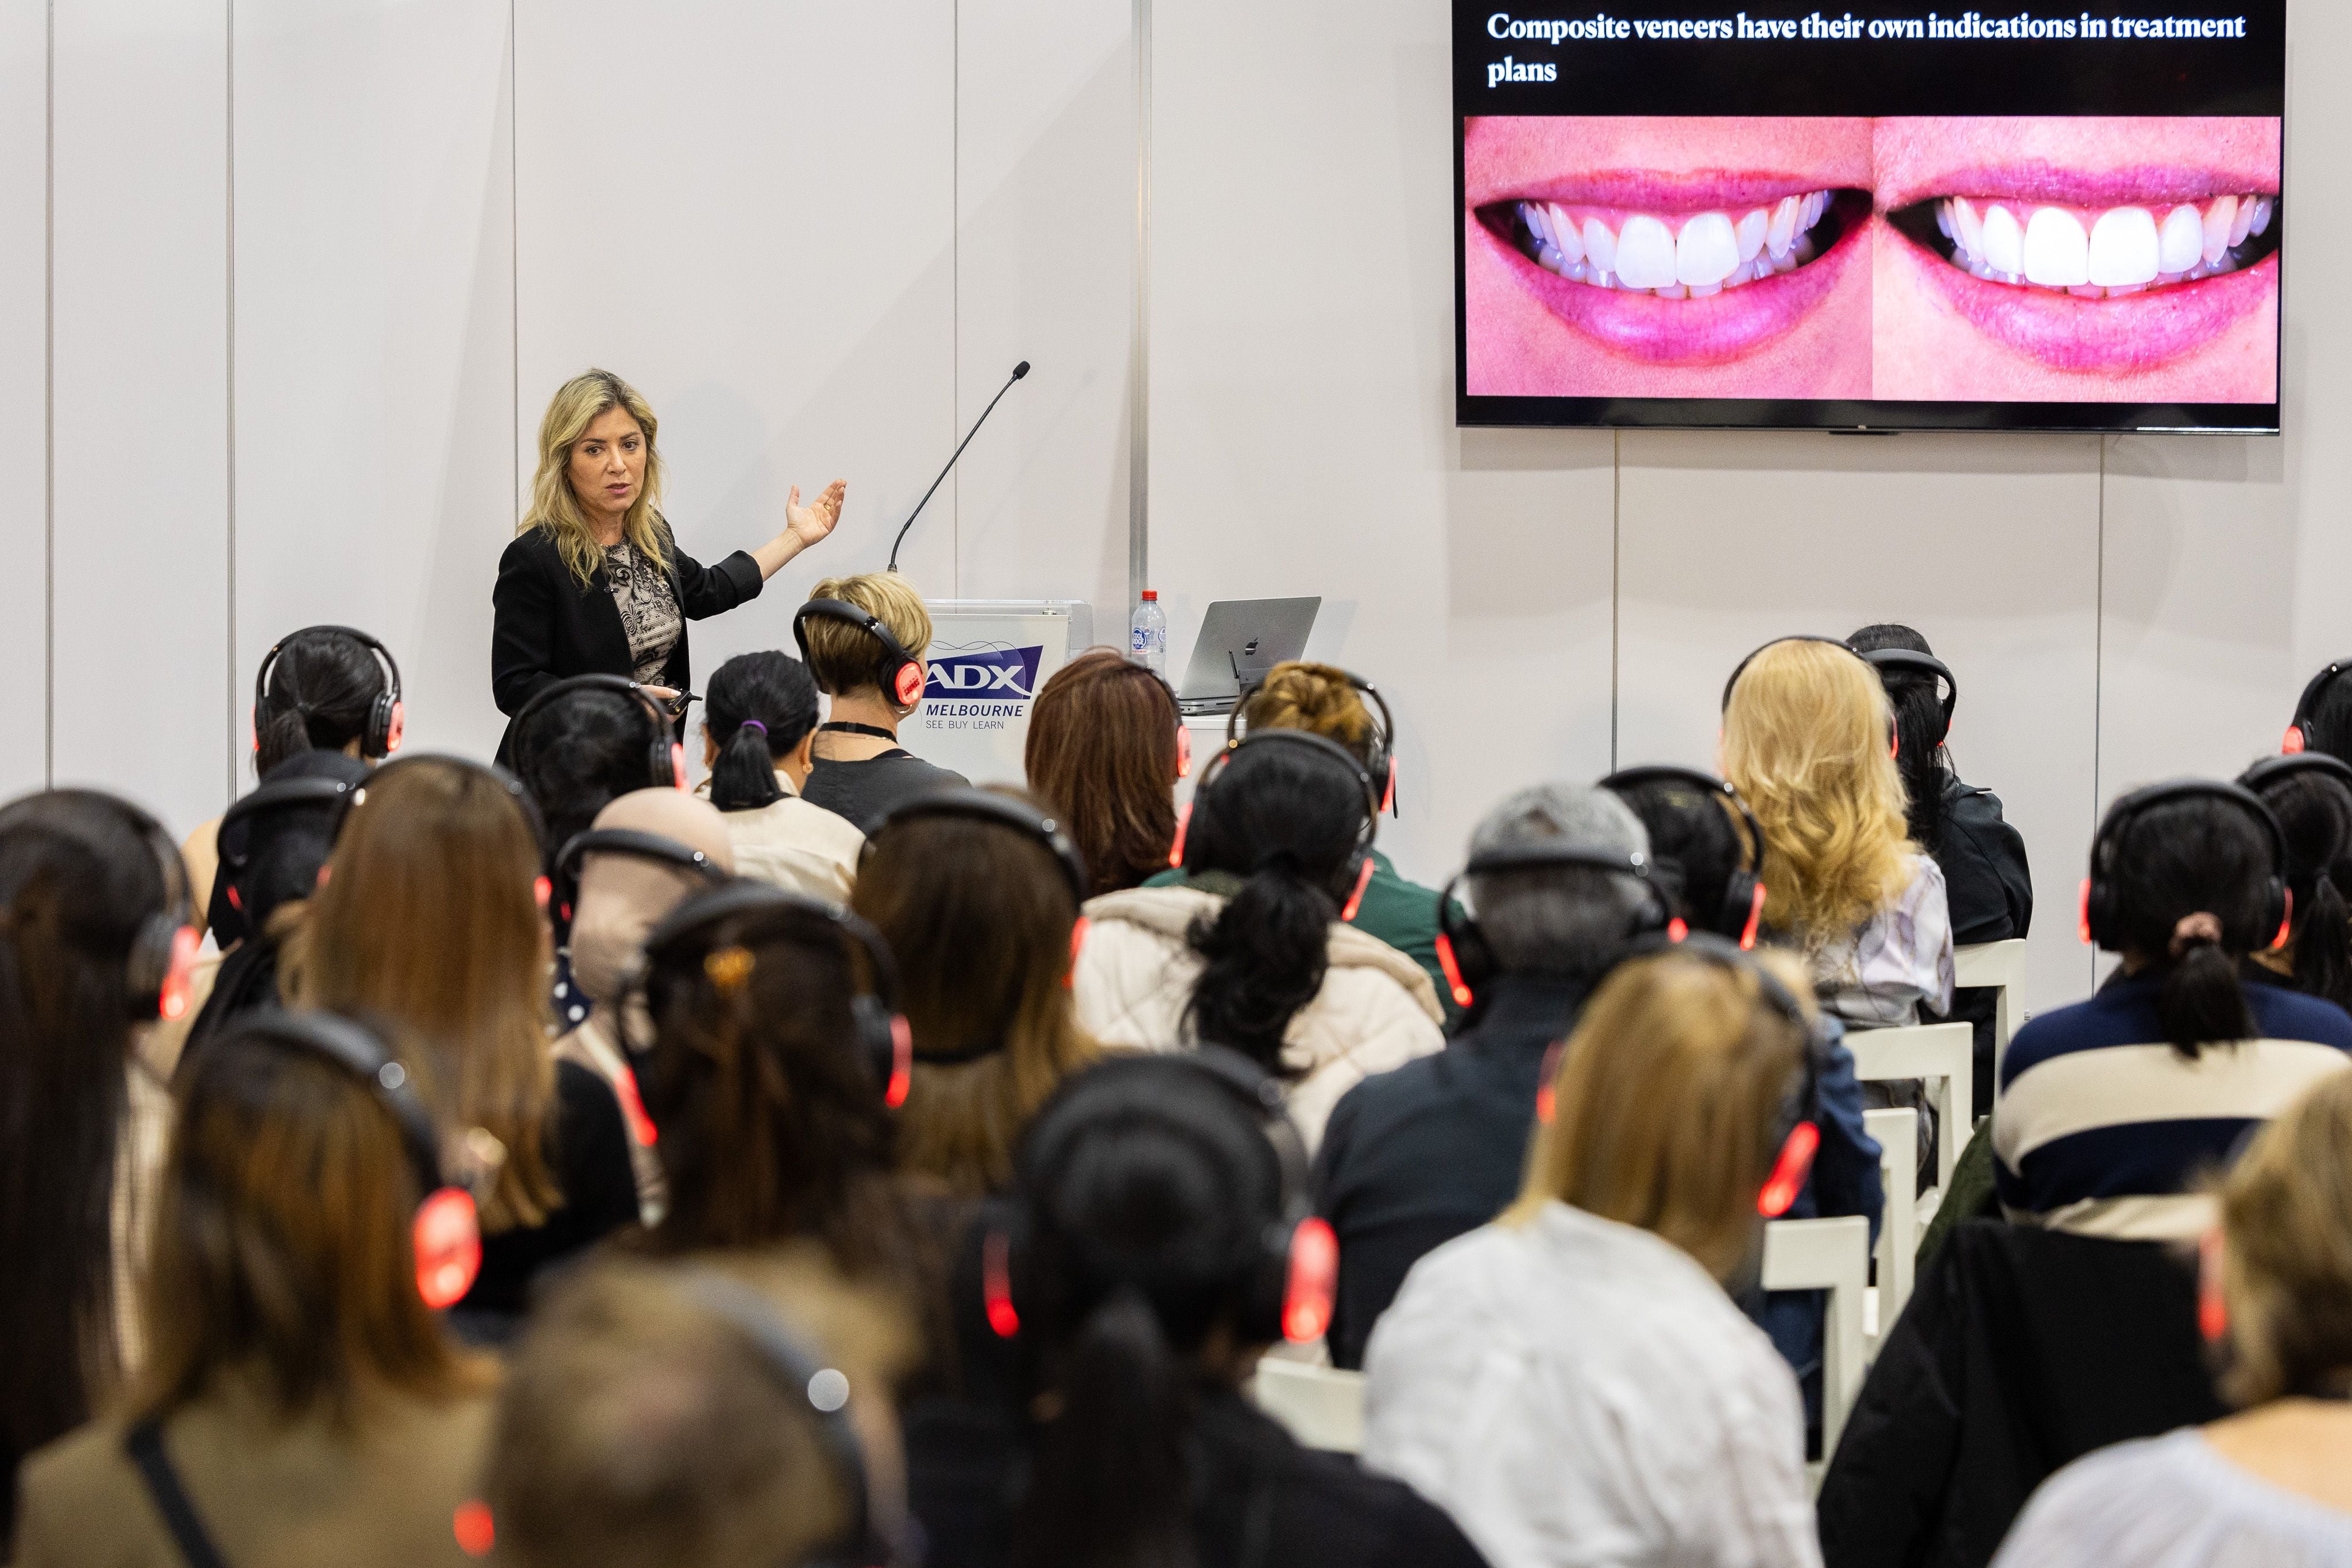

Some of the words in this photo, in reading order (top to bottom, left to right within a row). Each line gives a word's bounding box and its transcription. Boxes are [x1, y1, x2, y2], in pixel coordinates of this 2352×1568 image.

[1487, 13, 1630, 45] Composite
[1633, 20, 1734, 39] veneers
[1736, 12, 1797, 39] have
[1800, 12, 1865, 39] their
[1868, 20, 1924, 38] own
[1928, 11, 2077, 38] indications
[2080, 12, 2107, 38] in
[2111, 16, 2246, 38] treatment
[1487, 55, 1557, 88] plans
[925, 663, 1031, 696] ADX
[926, 704, 1023, 717] MELBOURNE
[926, 721, 943, 729] SEE
[949, 721, 968, 729] BUY
[973, 721, 1004, 729] LEARN
